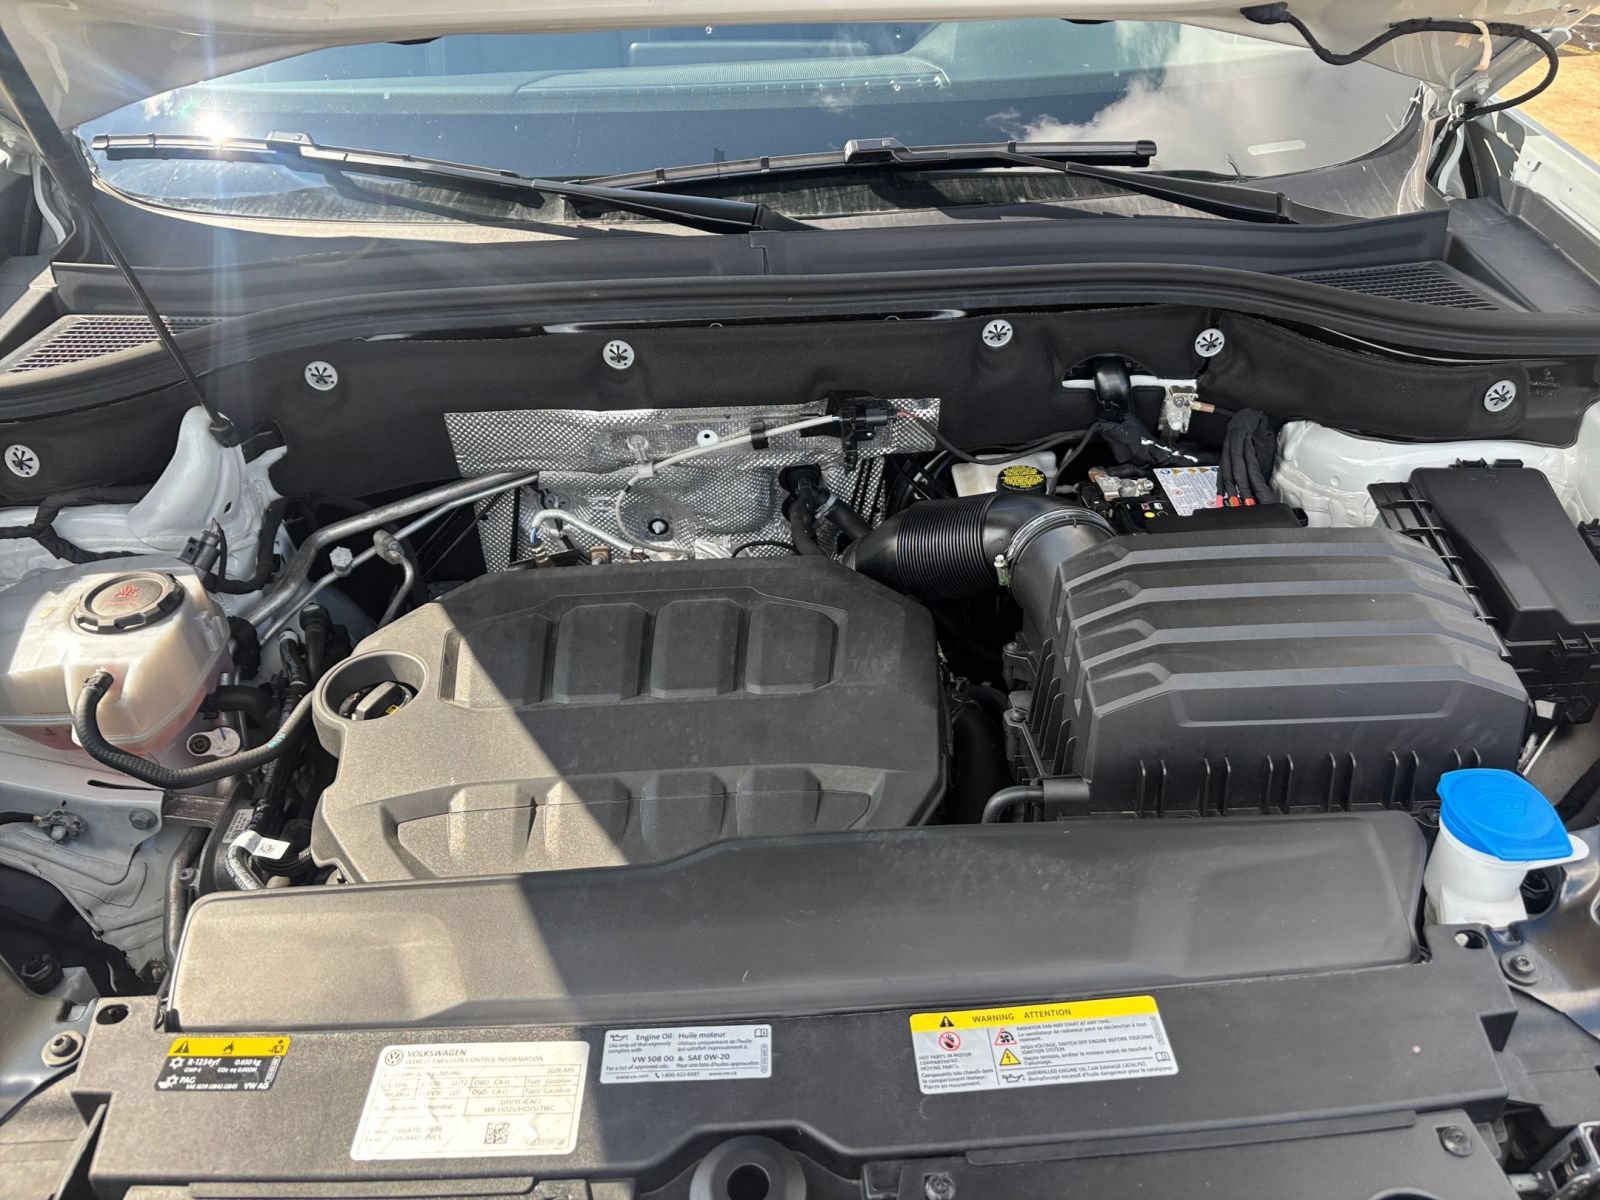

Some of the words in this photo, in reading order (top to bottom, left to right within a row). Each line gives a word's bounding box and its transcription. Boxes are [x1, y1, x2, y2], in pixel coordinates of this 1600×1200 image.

[972, 1013, 1014, 1023] WARNING
[1024, 1008, 1071, 1019] ATTENTION
[407, 1049, 466, 1057] VOLKSWAGEN
[187, 1058, 222, 1067] R-1234yf
[253, 1059, 262, 1067] kg
[179, 1076, 197, 1084] PAG
[244, 1082, 257, 1090] VW
[257, 1082, 269, 1090] AG
